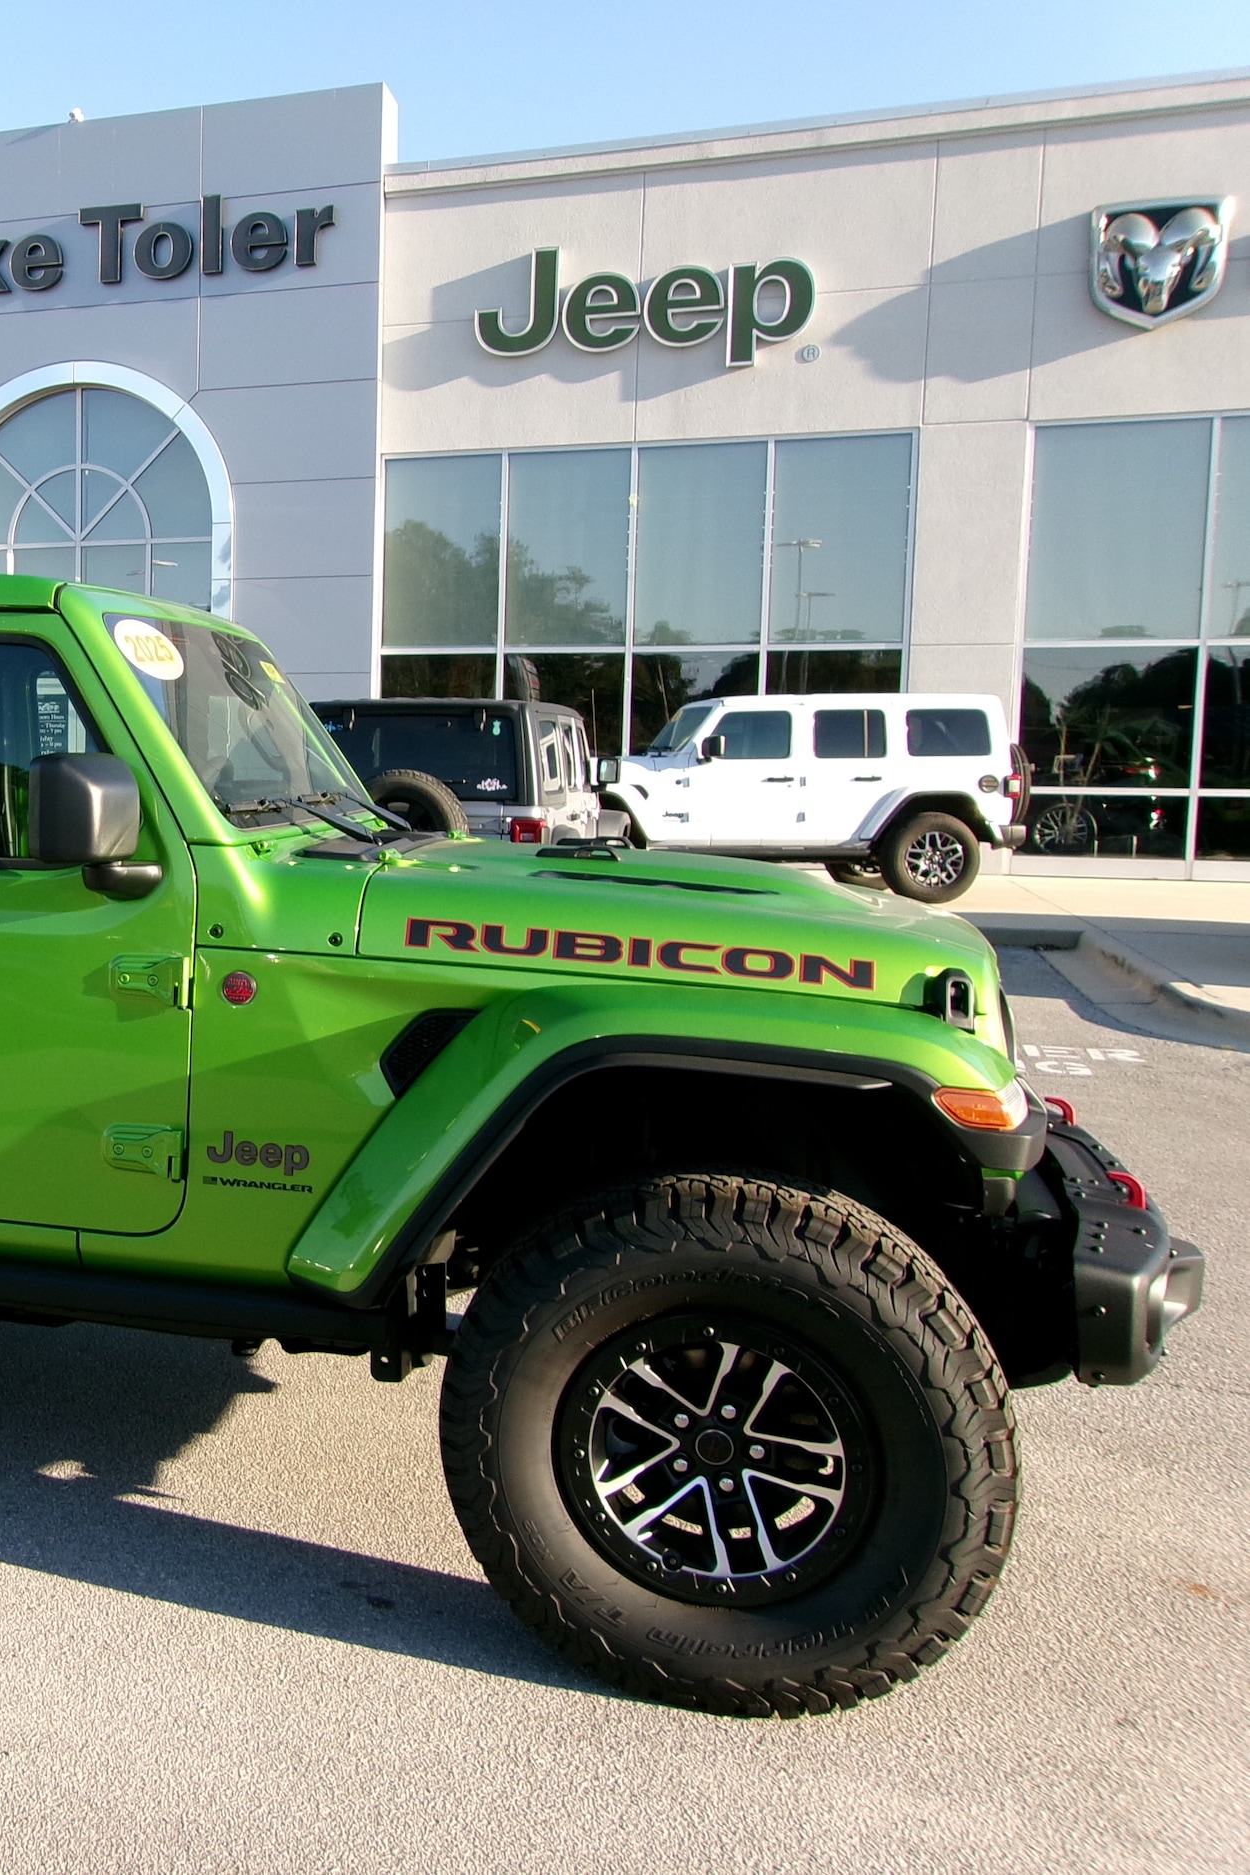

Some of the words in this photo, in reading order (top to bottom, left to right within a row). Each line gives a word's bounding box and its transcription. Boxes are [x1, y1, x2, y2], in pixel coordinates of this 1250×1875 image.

[78, 194, 337, 285] Toler
[473, 246, 817, 369] Jeep
[124, 635, 174, 663] 2025
[662, 811, 684, 819] Jeep
[403, 916, 876, 991] RUBICON
[206, 1131, 310, 1176] Jeep
[220, 1177, 313, 1194] WRANGLER
